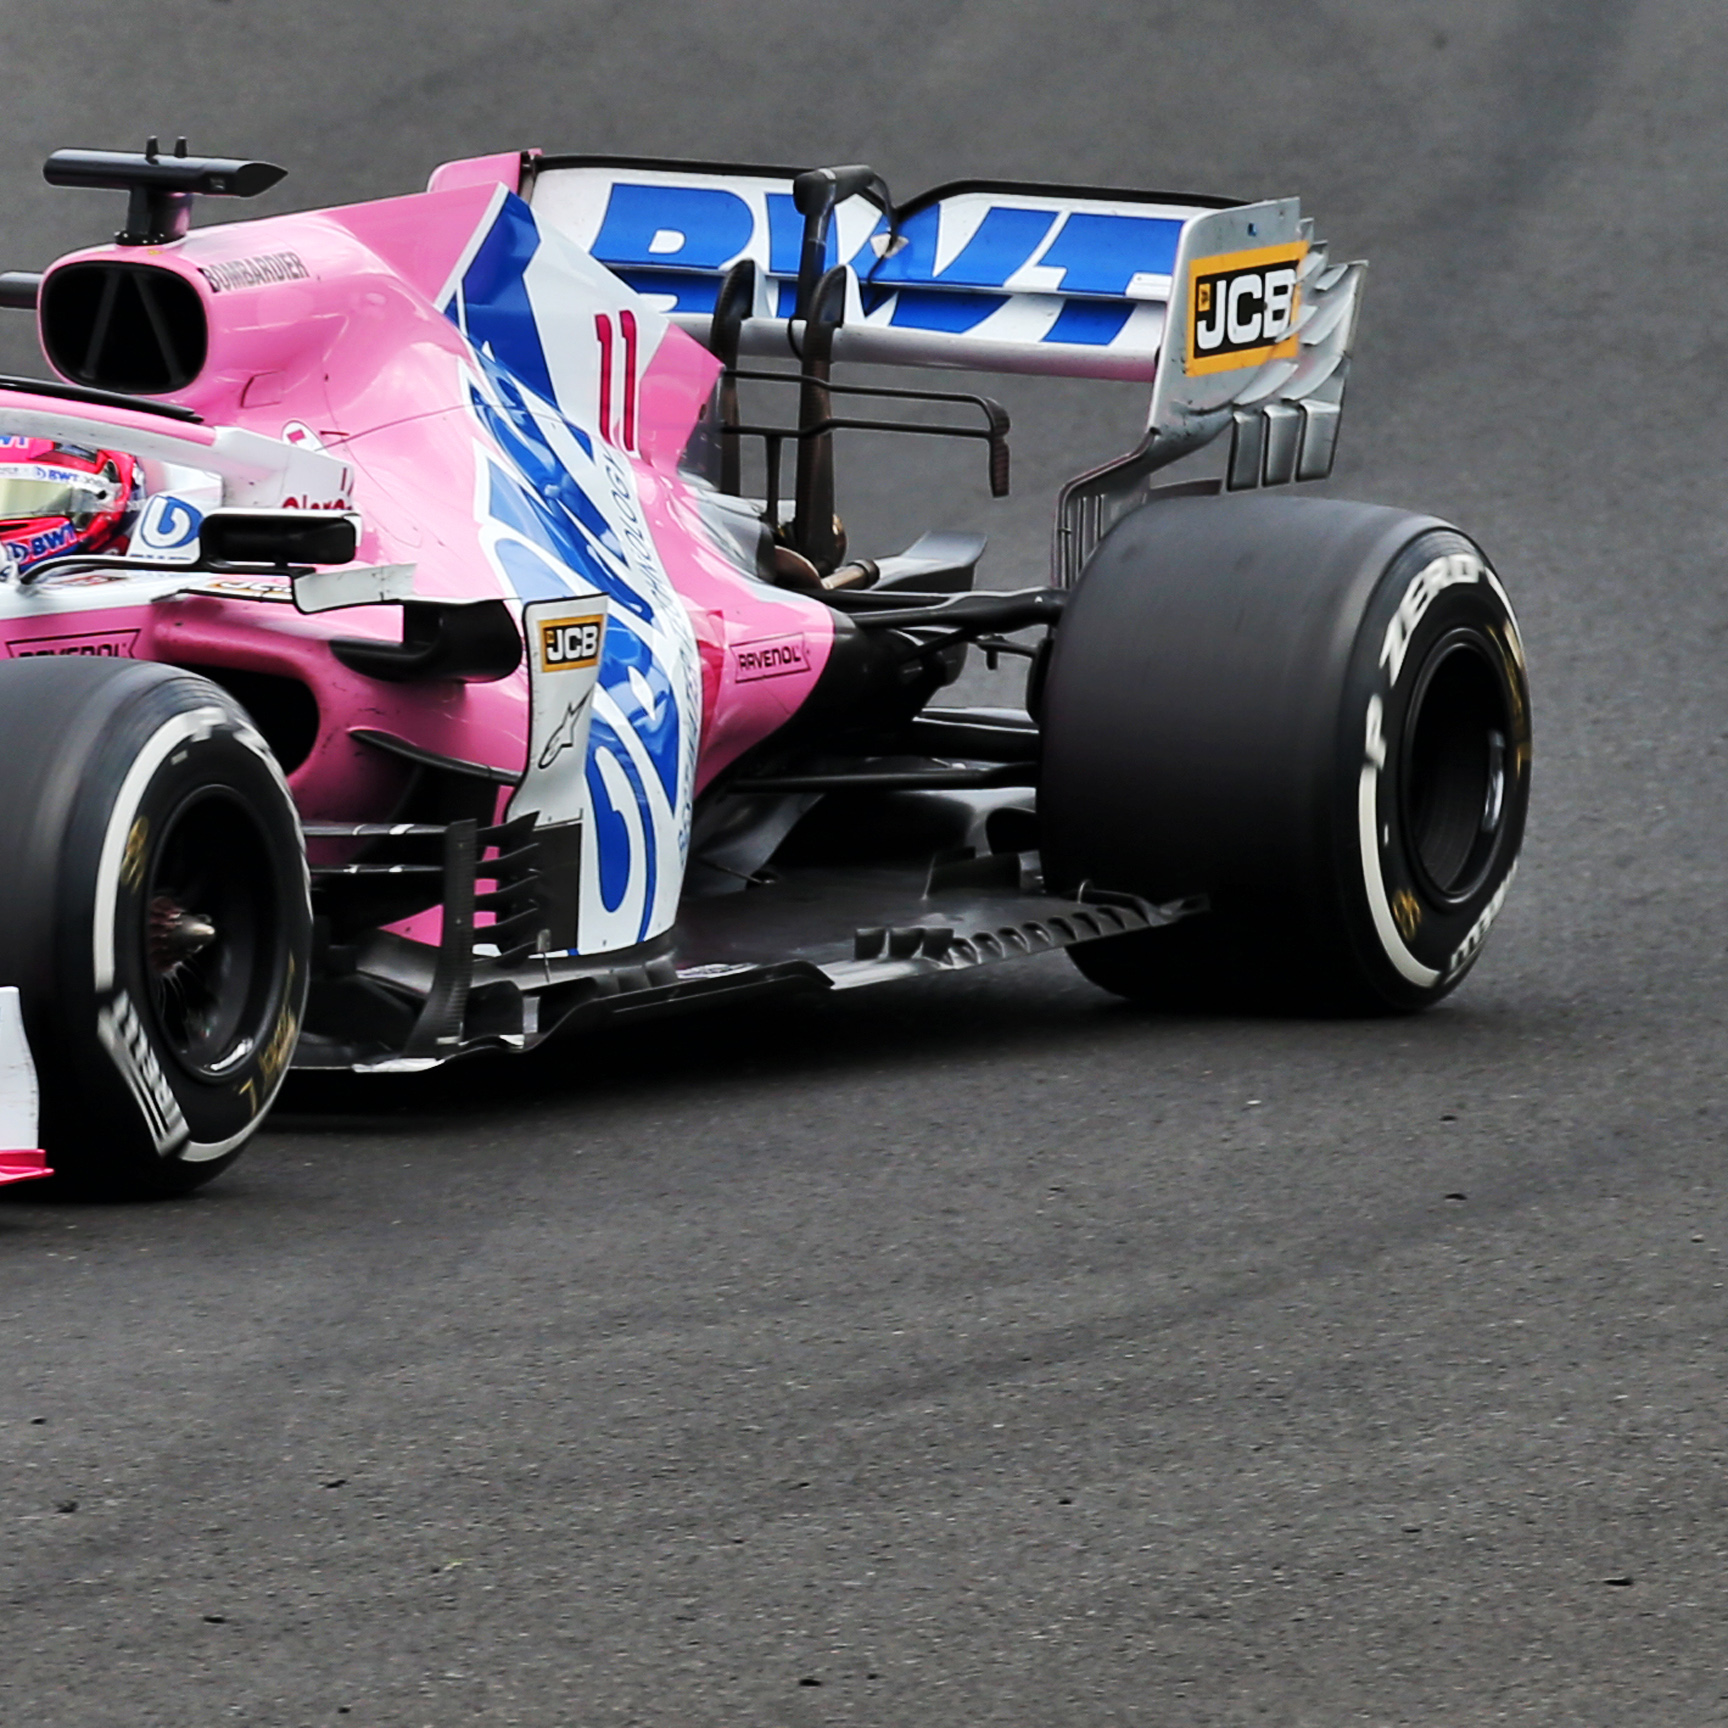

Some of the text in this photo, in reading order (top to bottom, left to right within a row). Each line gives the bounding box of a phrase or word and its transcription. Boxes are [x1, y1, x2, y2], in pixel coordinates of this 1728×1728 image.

[198, 251, 311, 293] BOMBARDIER
[590, 182, 1187, 346] BWT
[1195, 278, 1296, 351] JCB
[595, 309, 637, 452] 11
[30, 521, 77, 556] BWT
[547, 625, 600, 661] JCB
[738, 647, 802, 671] RAVENOL
